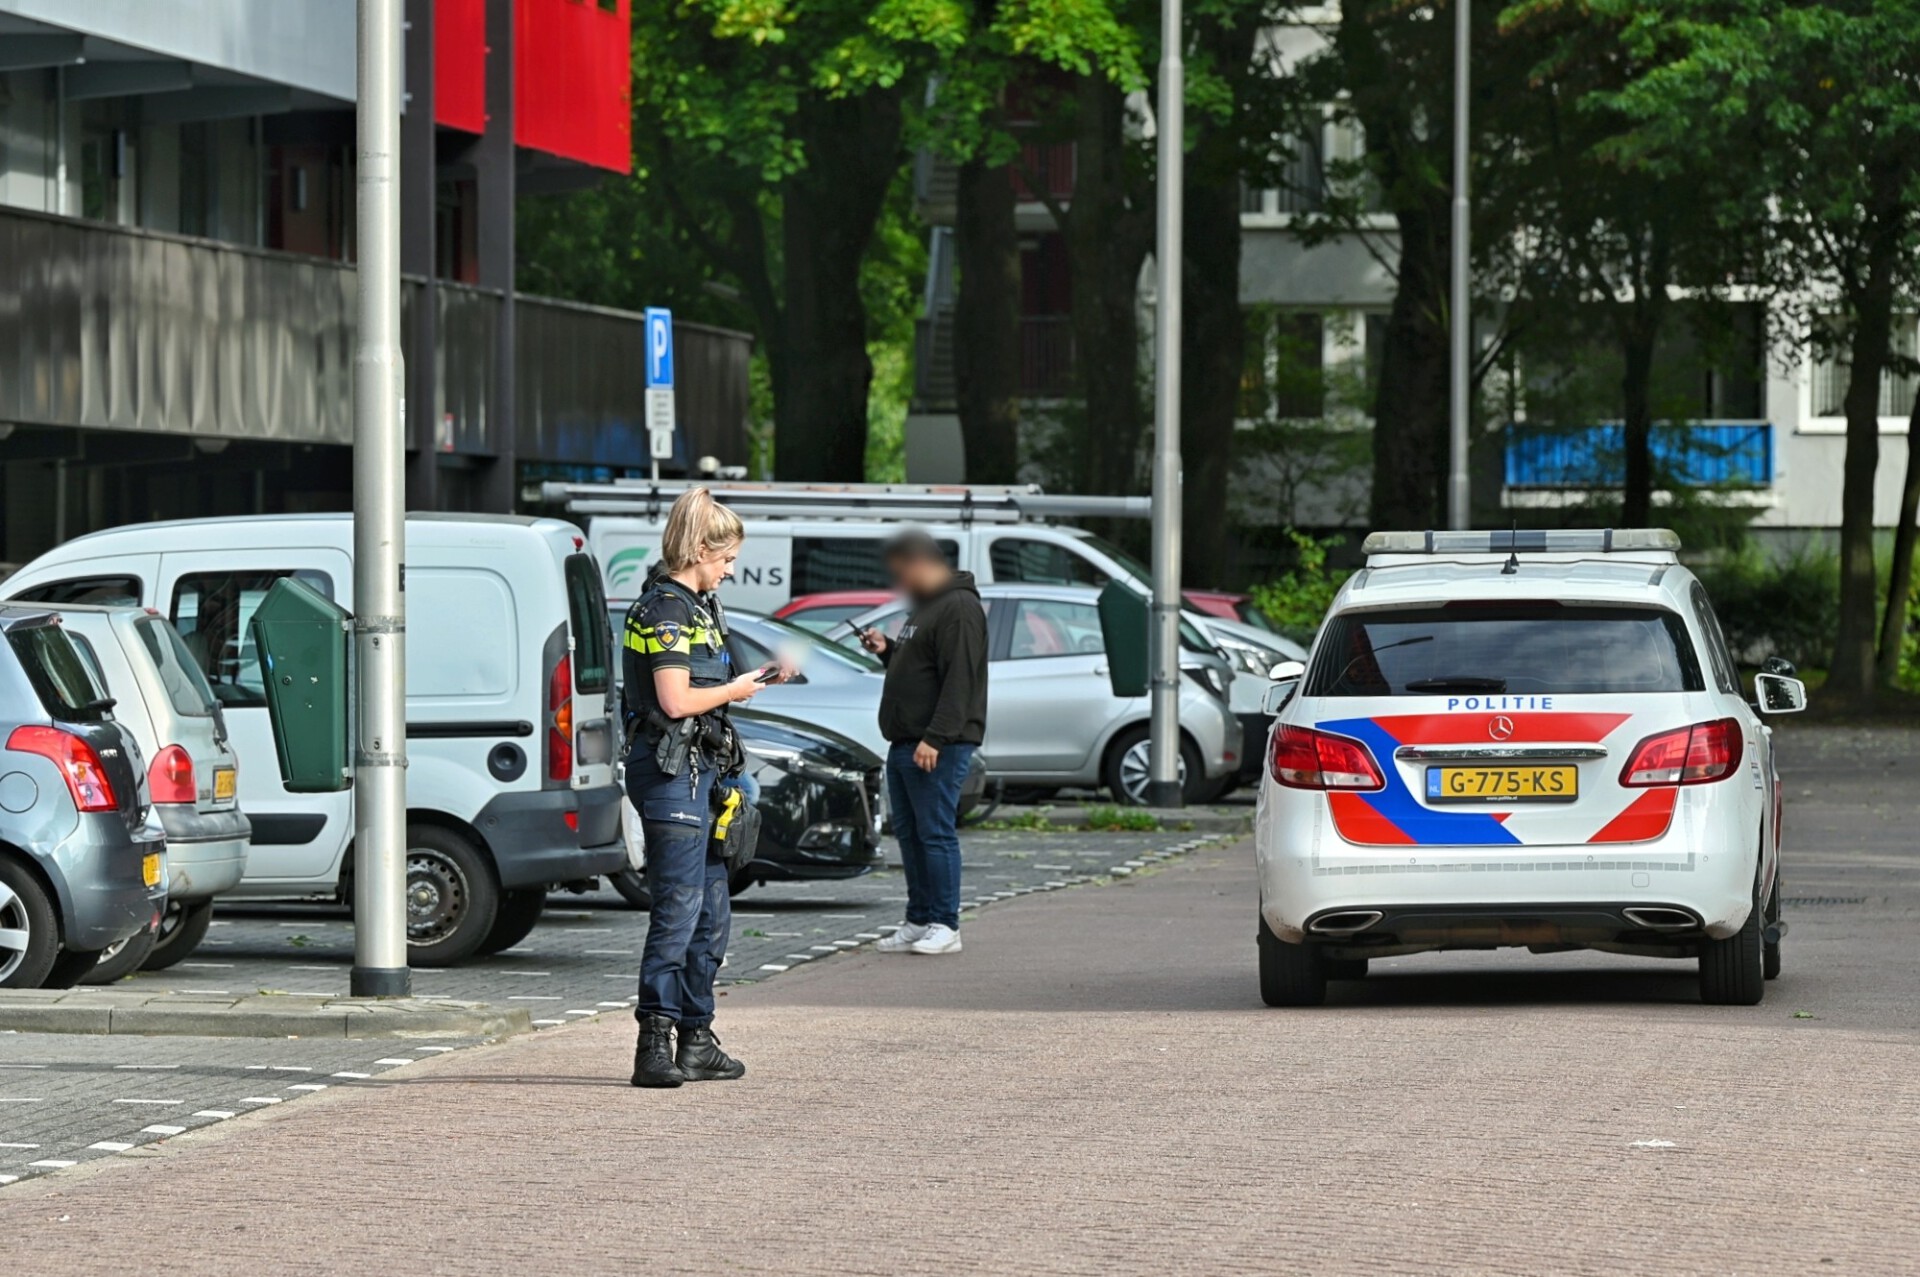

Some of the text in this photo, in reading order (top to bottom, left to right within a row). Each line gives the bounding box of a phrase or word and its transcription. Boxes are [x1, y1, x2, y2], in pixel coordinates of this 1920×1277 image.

[653, 318, 667, 379] P
[717, 567, 783, 586] ANS
[1448, 697, 1553, 710] POLITIE
[1429, 785, 1440, 793] NL
[1450, 771, 1564, 793] G-775-KS
